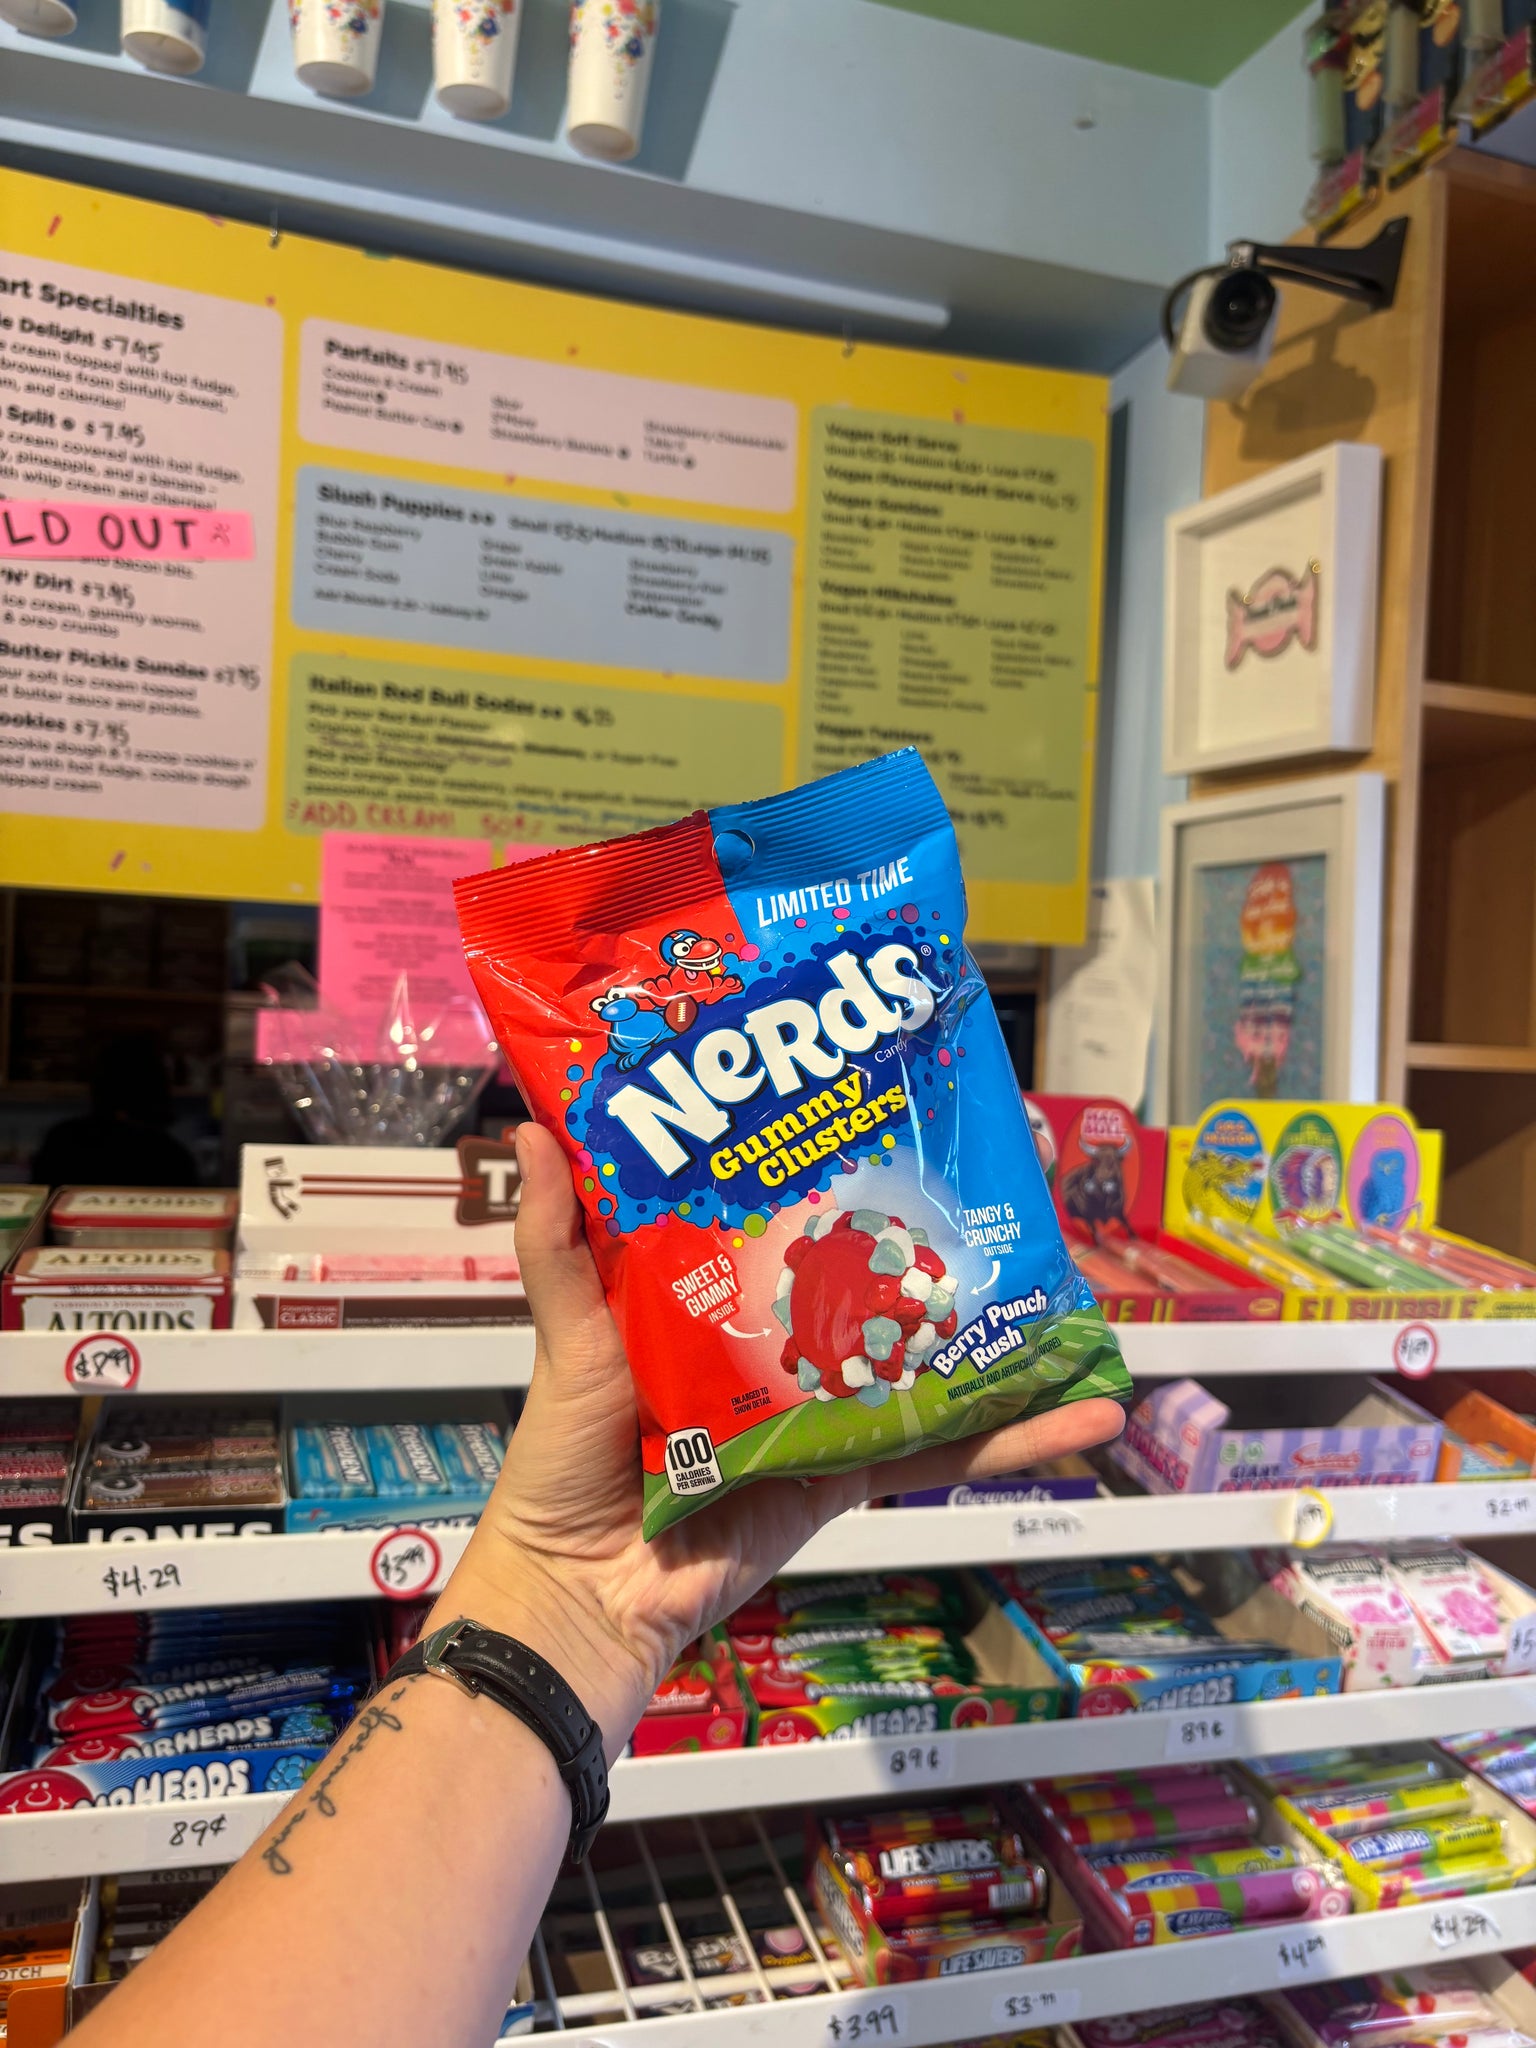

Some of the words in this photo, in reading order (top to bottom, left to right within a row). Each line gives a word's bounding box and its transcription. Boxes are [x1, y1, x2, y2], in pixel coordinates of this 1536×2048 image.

[40, 282, 186, 330] Specialties
[19, 316, 95, 346] Delight
[324, 338, 410, 371] Parfaits
[6, 404, 56, 428] Split
[316, 481, 378, 508] Slush
[379, 492, 466, 523] Puppies
[97, 513, 198, 551] OUT
[34, 571, 73, 593] Dirt
[67, 648, 130, 672] Pickle
[134, 656, 209, 681] Sundae
[756, 878, 852, 929] LIMITED
[856, 856, 914, 903] TIME
[873, 1037, 910, 1065] Candy
[709, 1071, 865, 1181] Gummy
[758, 1084, 909, 1188] Clusters
[962, 1204, 1001, 1227] TANGY
[1003, 1203, 1015, 1220] &
[964, 1221, 1021, 1248] CRUNCHY
[983, 1243, 1015, 1257] OUTSIDE
[45, 1252, 203, 1266] ALTOIDS
[671, 1259, 719, 1300] SWEET
[716, 1253, 733, 1274] &
[685, 1273, 738, 1318] GUMMY
[708, 1300, 736, 1324] INSIDE
[280, 1312, 337, 1325] CLASSIC
[933, 1319, 987, 1376] Berry
[985, 1289, 1048, 1329] Punch
[970, 1325, 1024, 1371] Rush
[731, 1387, 761, 1407] ENLARGED
[760, 1386, 769, 1396] TO
[947, 1375, 987, 1401] NATURALLY
[986, 1371, 1001, 1386] AND
[733, 1402, 753, 1416] SHOW
[752, 1396, 772, 1410] DETAIL
[667, 1432, 713, 1471] 100
[213, 1481, 278, 1496] COLA
[675, 1466, 712, 1482] CALORIES
[676, 1481, 690, 1491] PER
[690, 1475, 716, 1488] SERVING
[103, 1564, 182, 1598] $4.29
[119, 1715, 274, 1761] AIRHEADS
[168, 1814, 228, 1847] 89¢
[829, 2004, 899, 2041] $3.99
